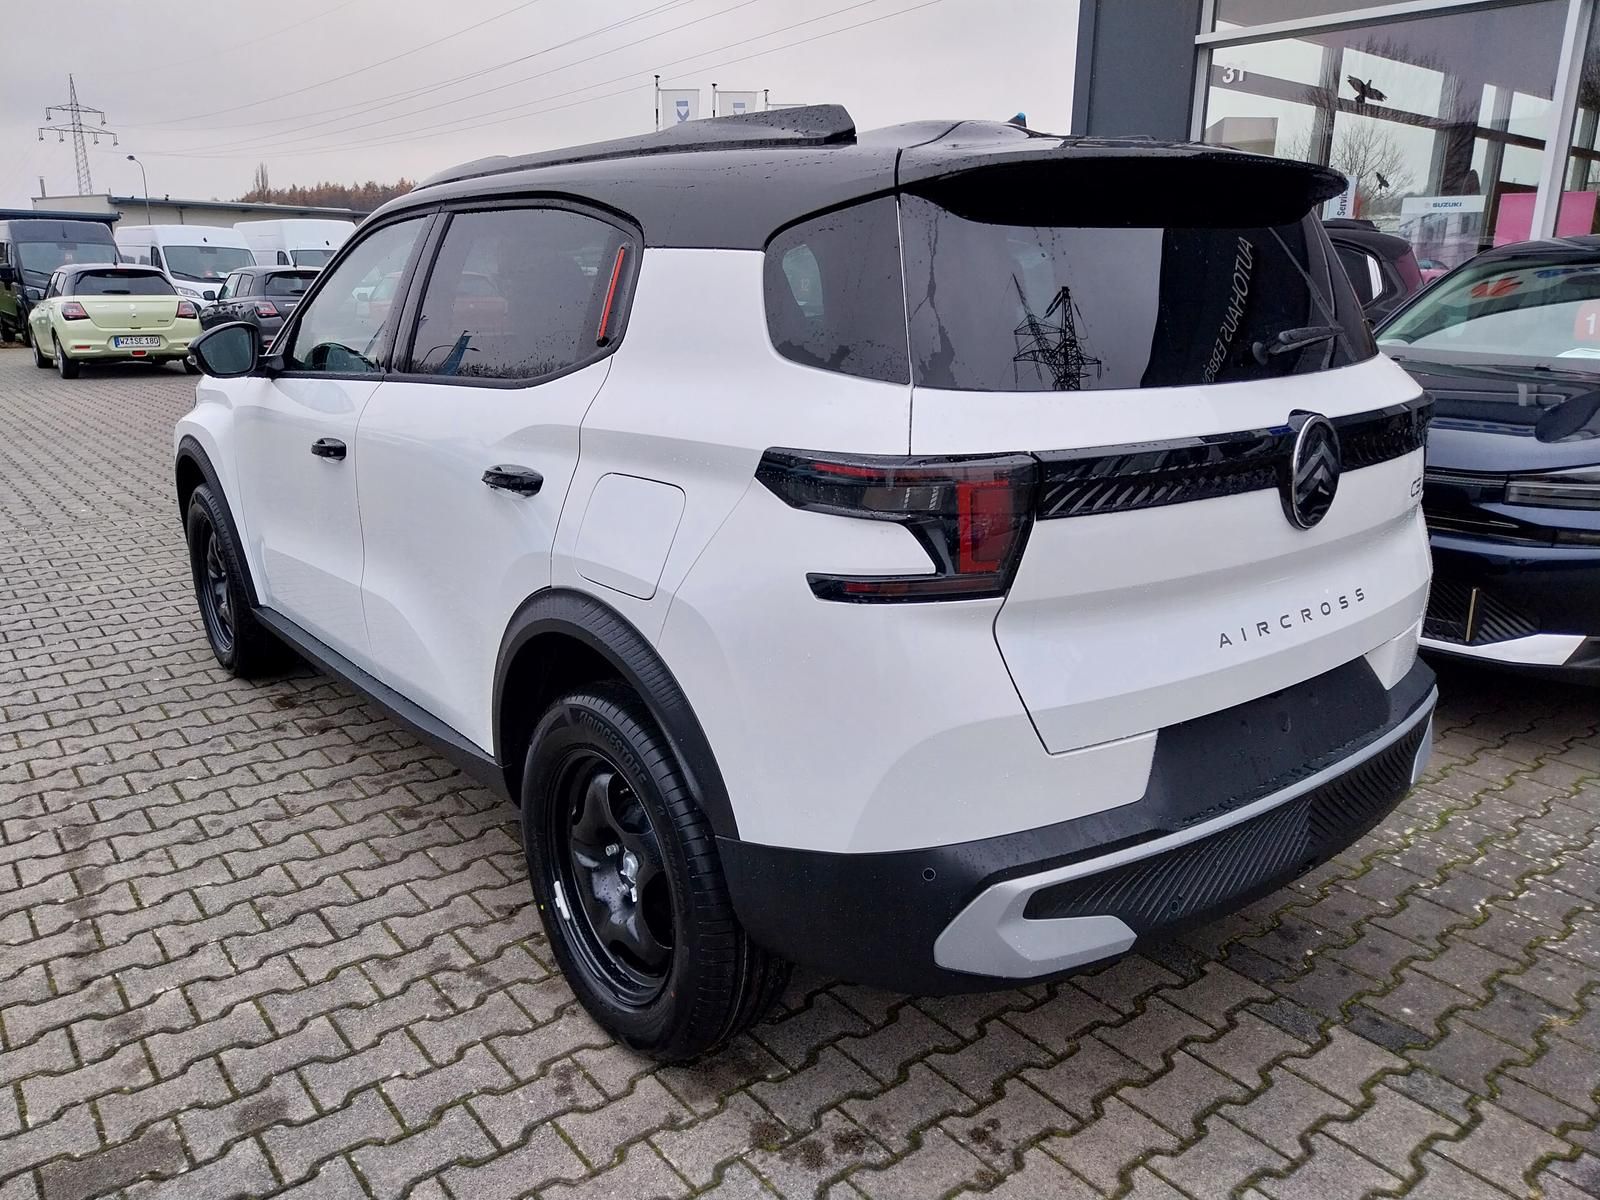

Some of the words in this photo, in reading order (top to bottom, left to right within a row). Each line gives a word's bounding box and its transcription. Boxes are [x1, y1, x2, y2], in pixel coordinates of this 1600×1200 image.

[1337, 190, 1349, 216] Servic
[1219, 588, 1365, 648] AIRCROSS
[578, 711, 648, 785] BRIDGESTONE
